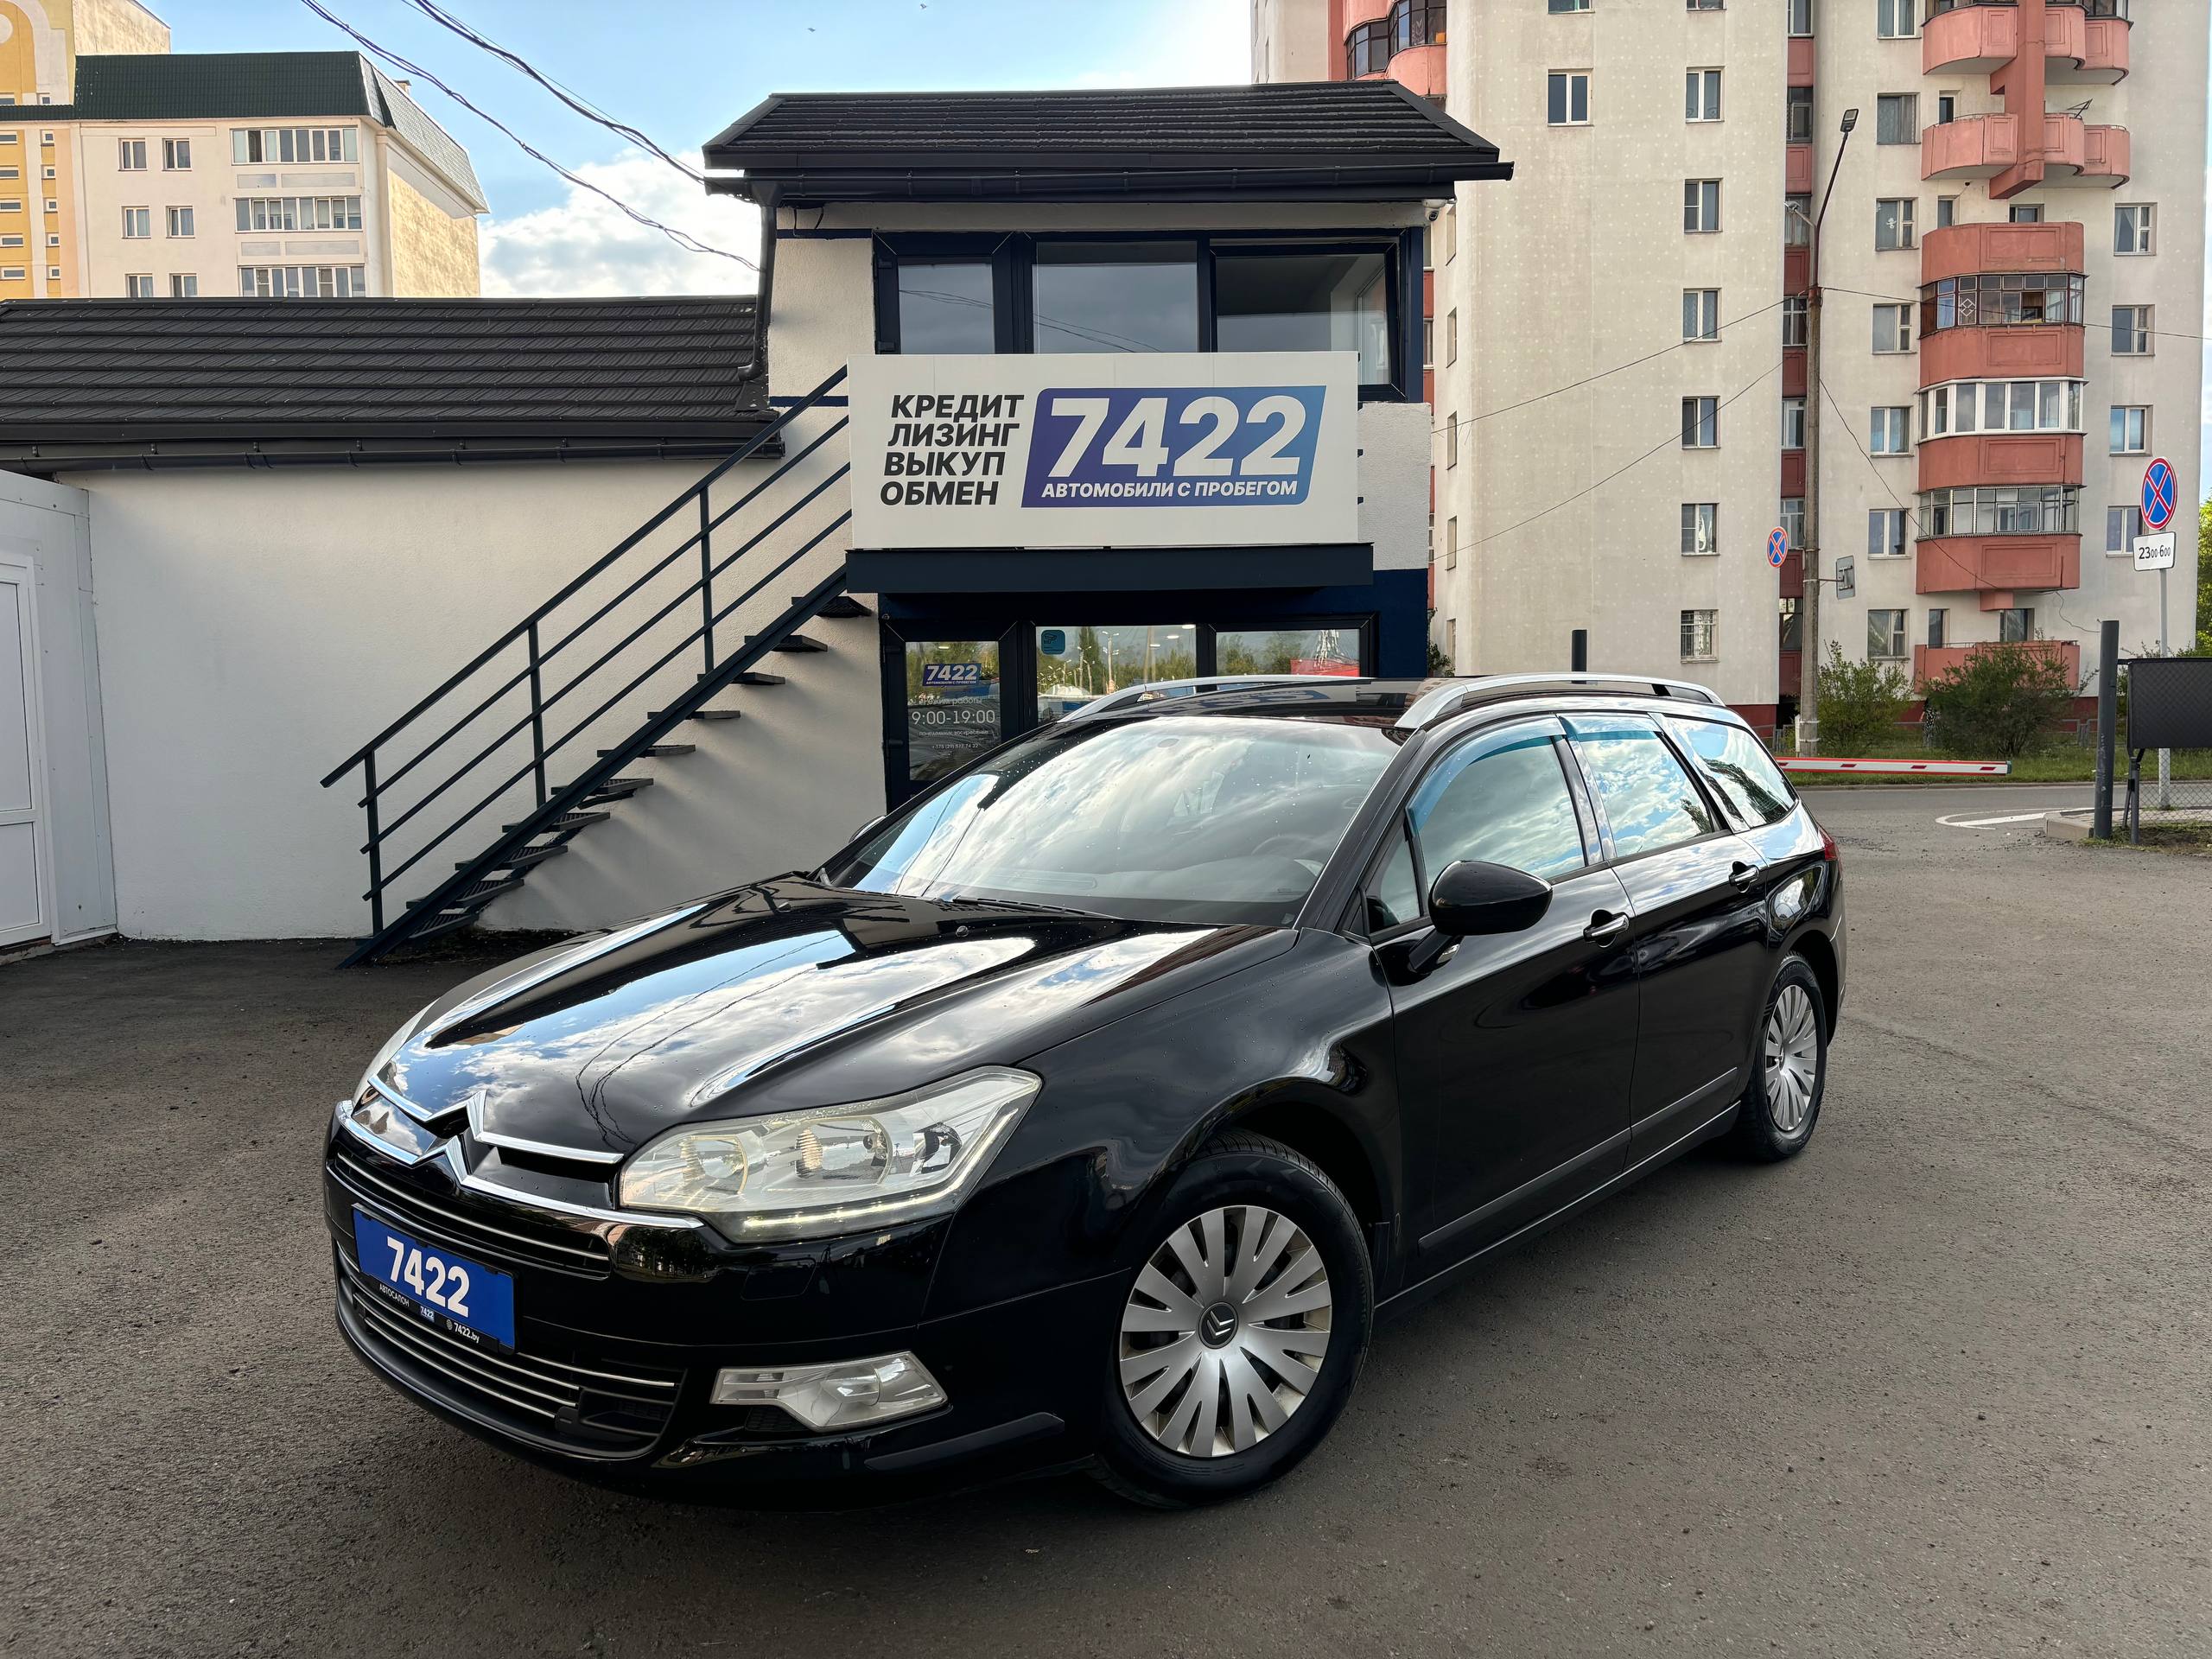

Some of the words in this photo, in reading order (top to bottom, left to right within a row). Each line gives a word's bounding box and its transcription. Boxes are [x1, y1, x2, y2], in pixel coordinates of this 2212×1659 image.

[891, 394, 1024, 423] КРЕДИТ
[887, 423, 1020, 447] ЛИЗИНГ
[1047, 395, 1306, 478] 7422
[884, 452, 1005, 476] ВЫКУП
[880, 481, 998, 505] ОБМЕН
[1041, 482, 1174, 498] АВТОМОБИЛИ
[1178, 482, 1191, 497] С
[1194, 480, 1298, 497] ПРОБЕГОМ
[927, 664, 978, 681] 7422
[912, 710, 995, 724] 9:00-19:00
[387, 1236, 469, 1318] 7422
[379, 1283, 410, 1306] АВТОСАЛОН
[454, 1323, 480, 1344] 7422.by
